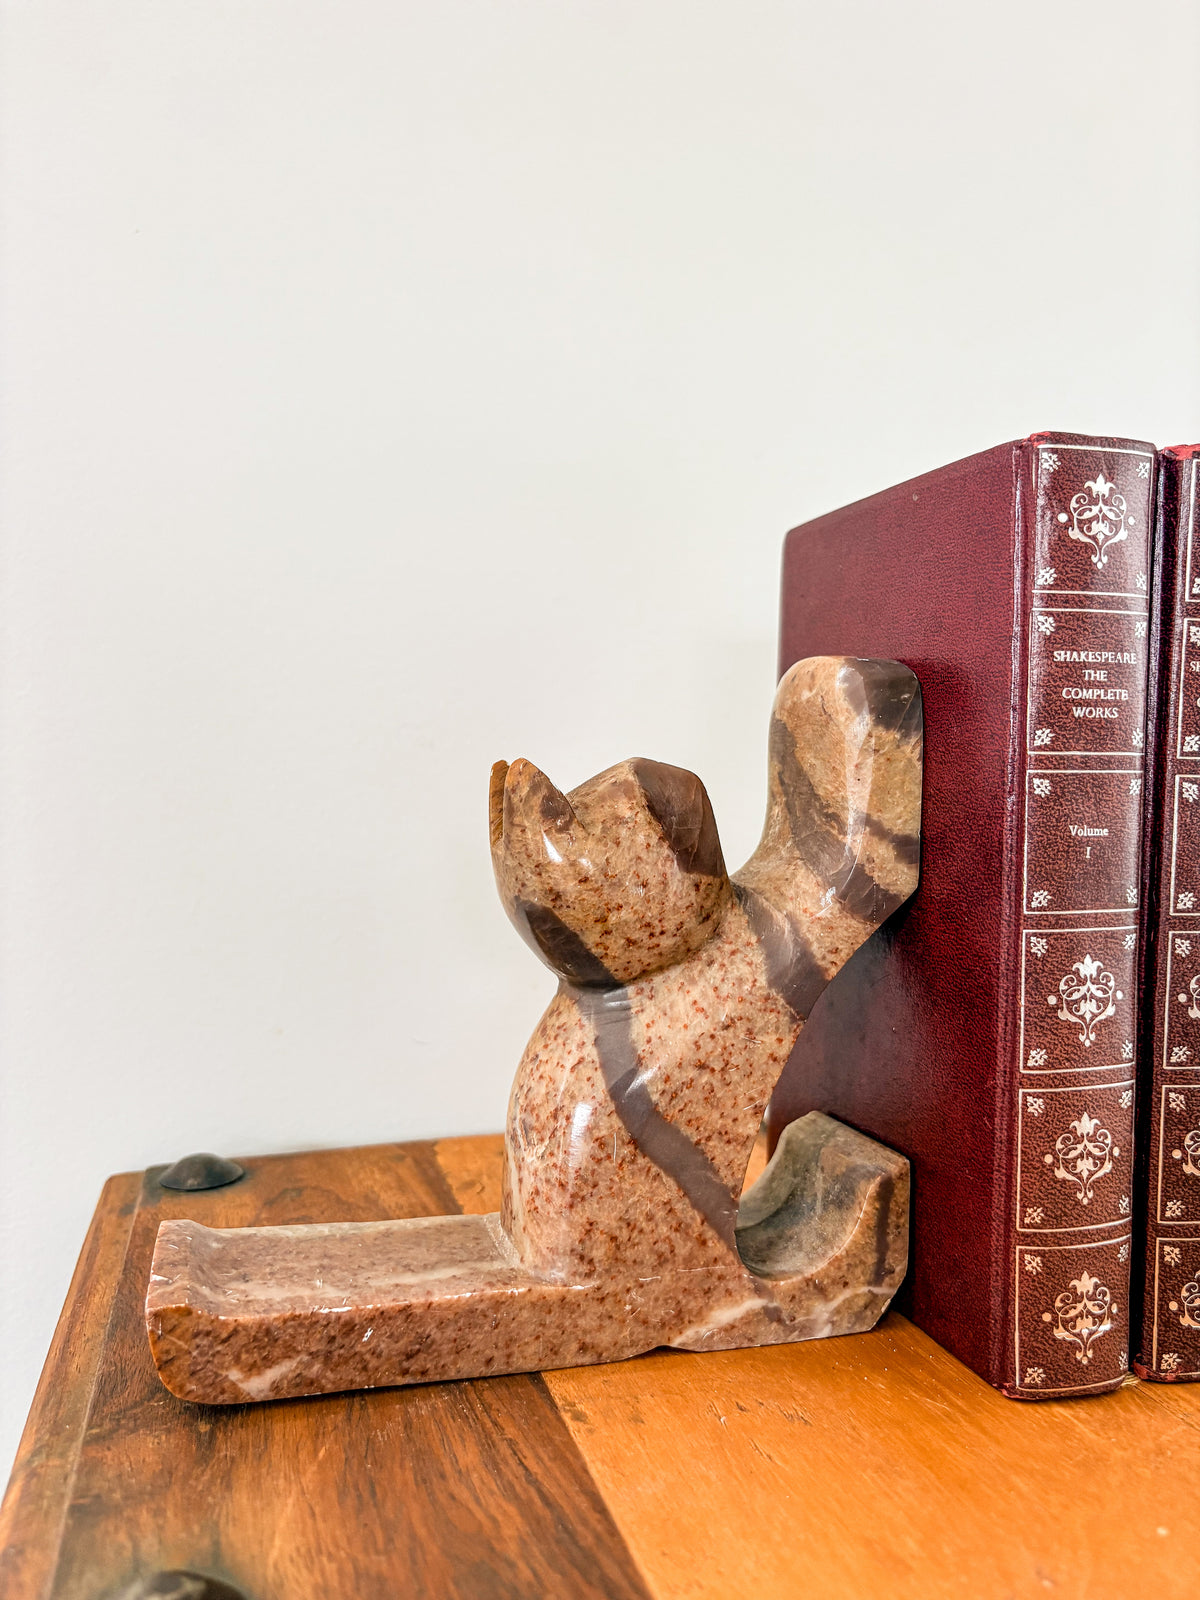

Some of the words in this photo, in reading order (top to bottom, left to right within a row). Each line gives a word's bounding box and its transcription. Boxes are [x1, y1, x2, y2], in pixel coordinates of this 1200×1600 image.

[1053, 650, 1137, 664] SHAKESPEARE
[1082, 669, 1108, 681] THE
[1061, 687, 1129, 701] COMPLETE
[1072, 706, 1119, 719] WORKS
[1069, 825, 1109, 837] Volume
[1085, 847, 1092, 858] I
